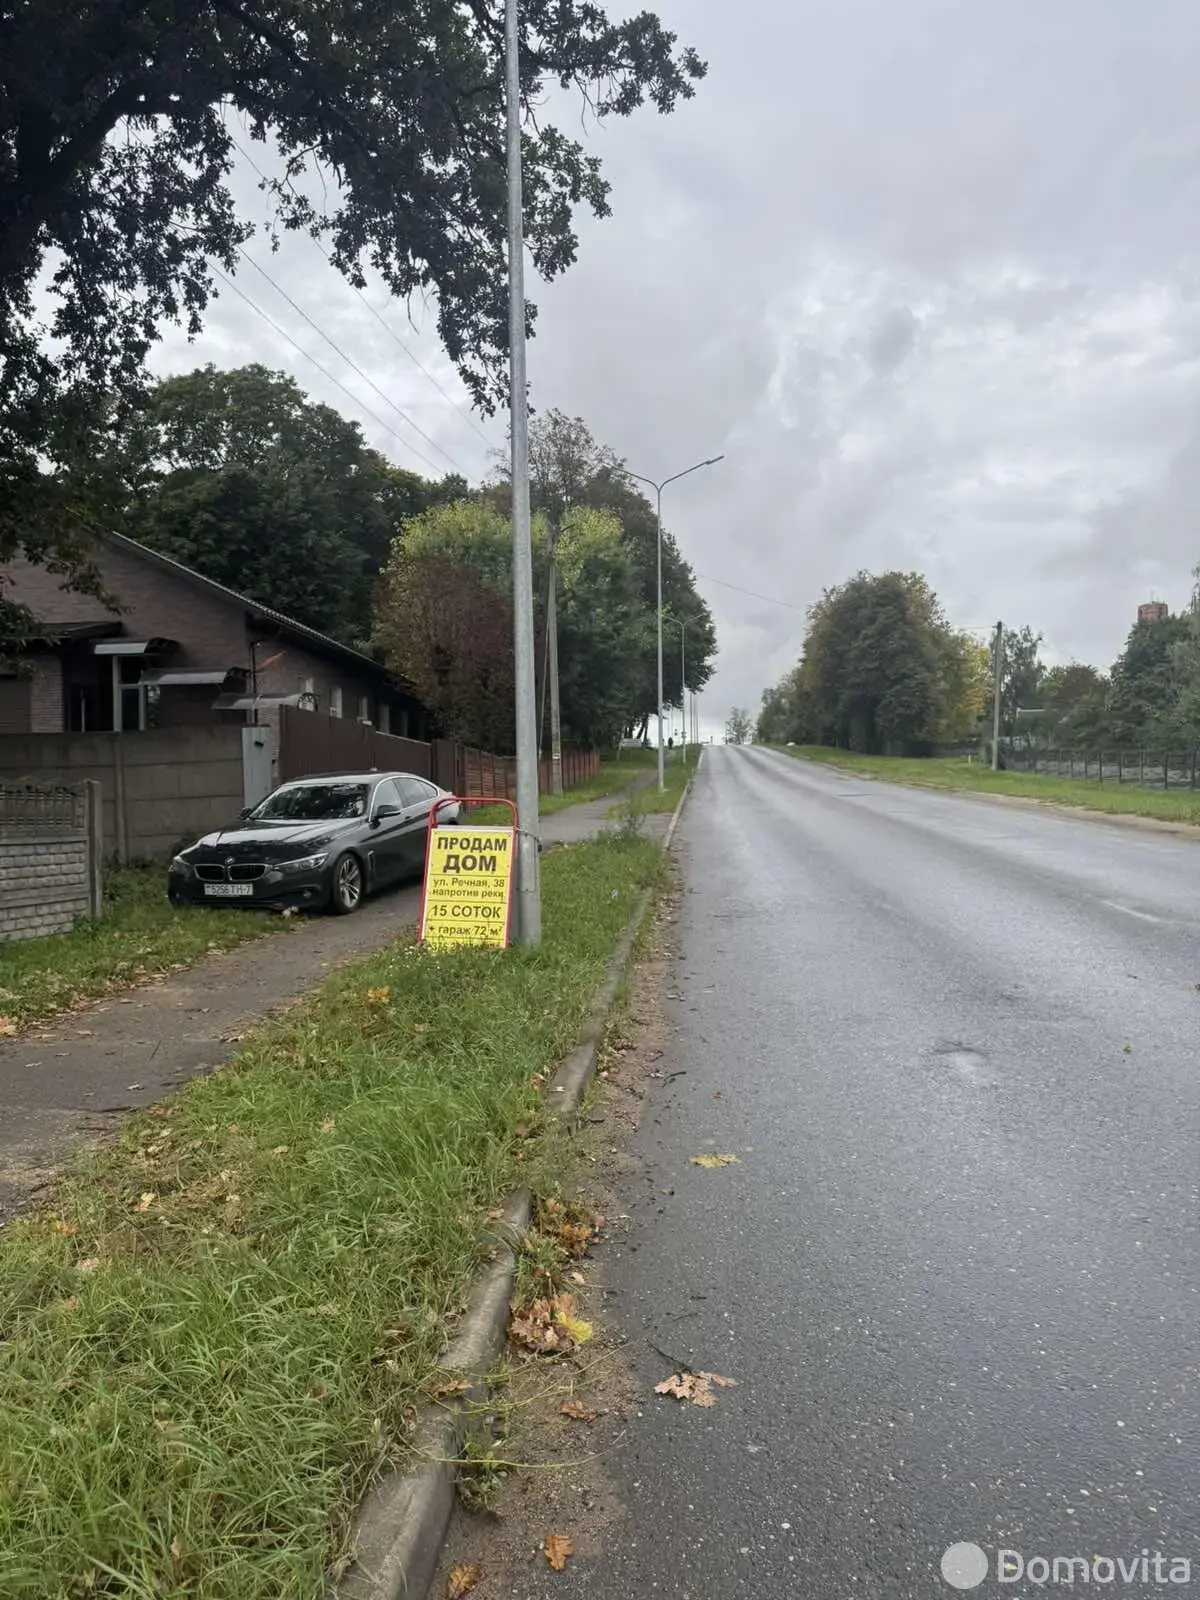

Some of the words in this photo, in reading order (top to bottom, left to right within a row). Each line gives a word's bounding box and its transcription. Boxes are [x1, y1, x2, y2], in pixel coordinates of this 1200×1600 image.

[437, 837, 507, 853] ПРОДАМ
[443, 854, 497, 873] ДОМ
[433, 878, 448, 888] ул.
[451, 877, 491, 888] Речная,
[432, 888, 479, 897] напротив
[481, 891, 504, 899] реки
[432, 904, 448, 917] 15
[451, 905, 502, 918] СОТОК
[438, 925, 471, 935] гараж
[473, 925, 487, 936] 72
